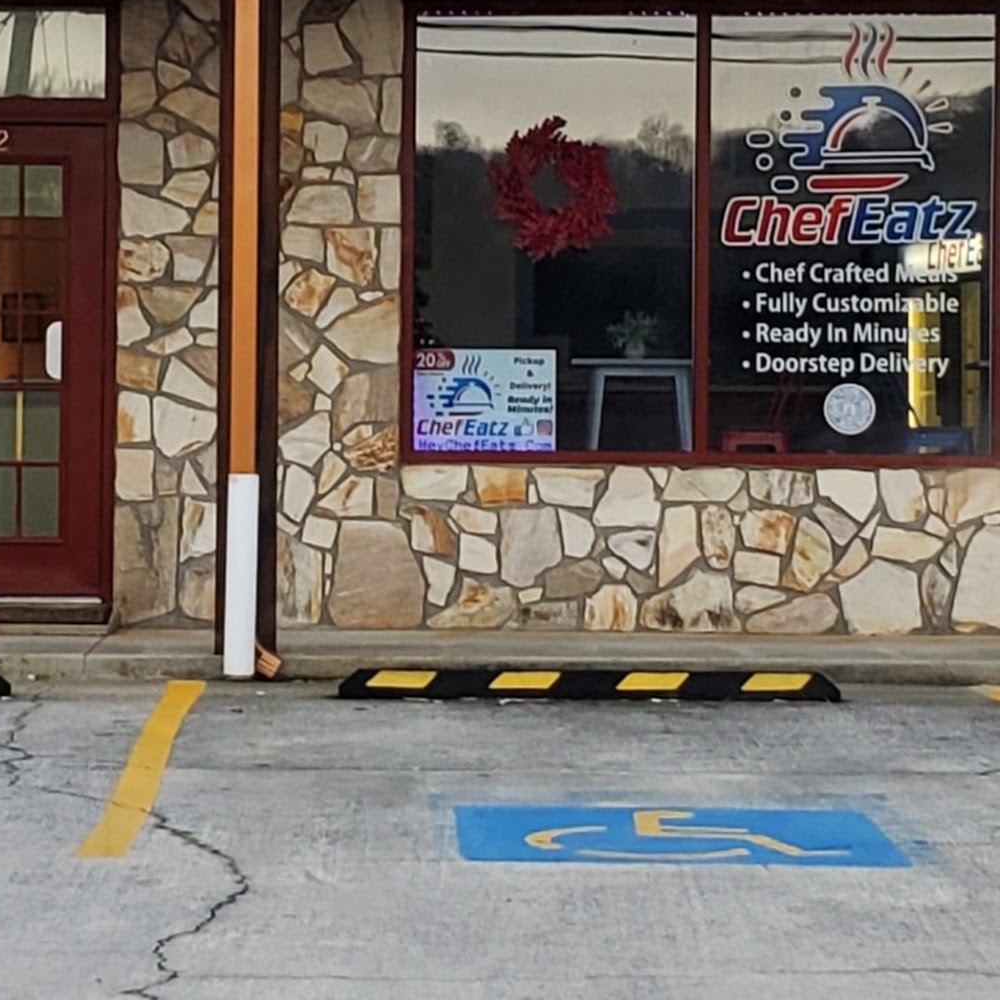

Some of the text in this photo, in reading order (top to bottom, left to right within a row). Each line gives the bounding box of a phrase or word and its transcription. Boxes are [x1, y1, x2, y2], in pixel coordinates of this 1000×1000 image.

[721, 194, 977, 245] ChefEatz
[755, 262, 805, 283] Chef
[809, 262, 889, 283] Crafted
[755, 292, 960, 318] Fully Customizable
[755, 322, 822, 347] Ready
[827, 323, 848, 343] In
[755, 353, 950, 378] Doorstep Delivery
[417, 419, 509, 436] ChefEatz
